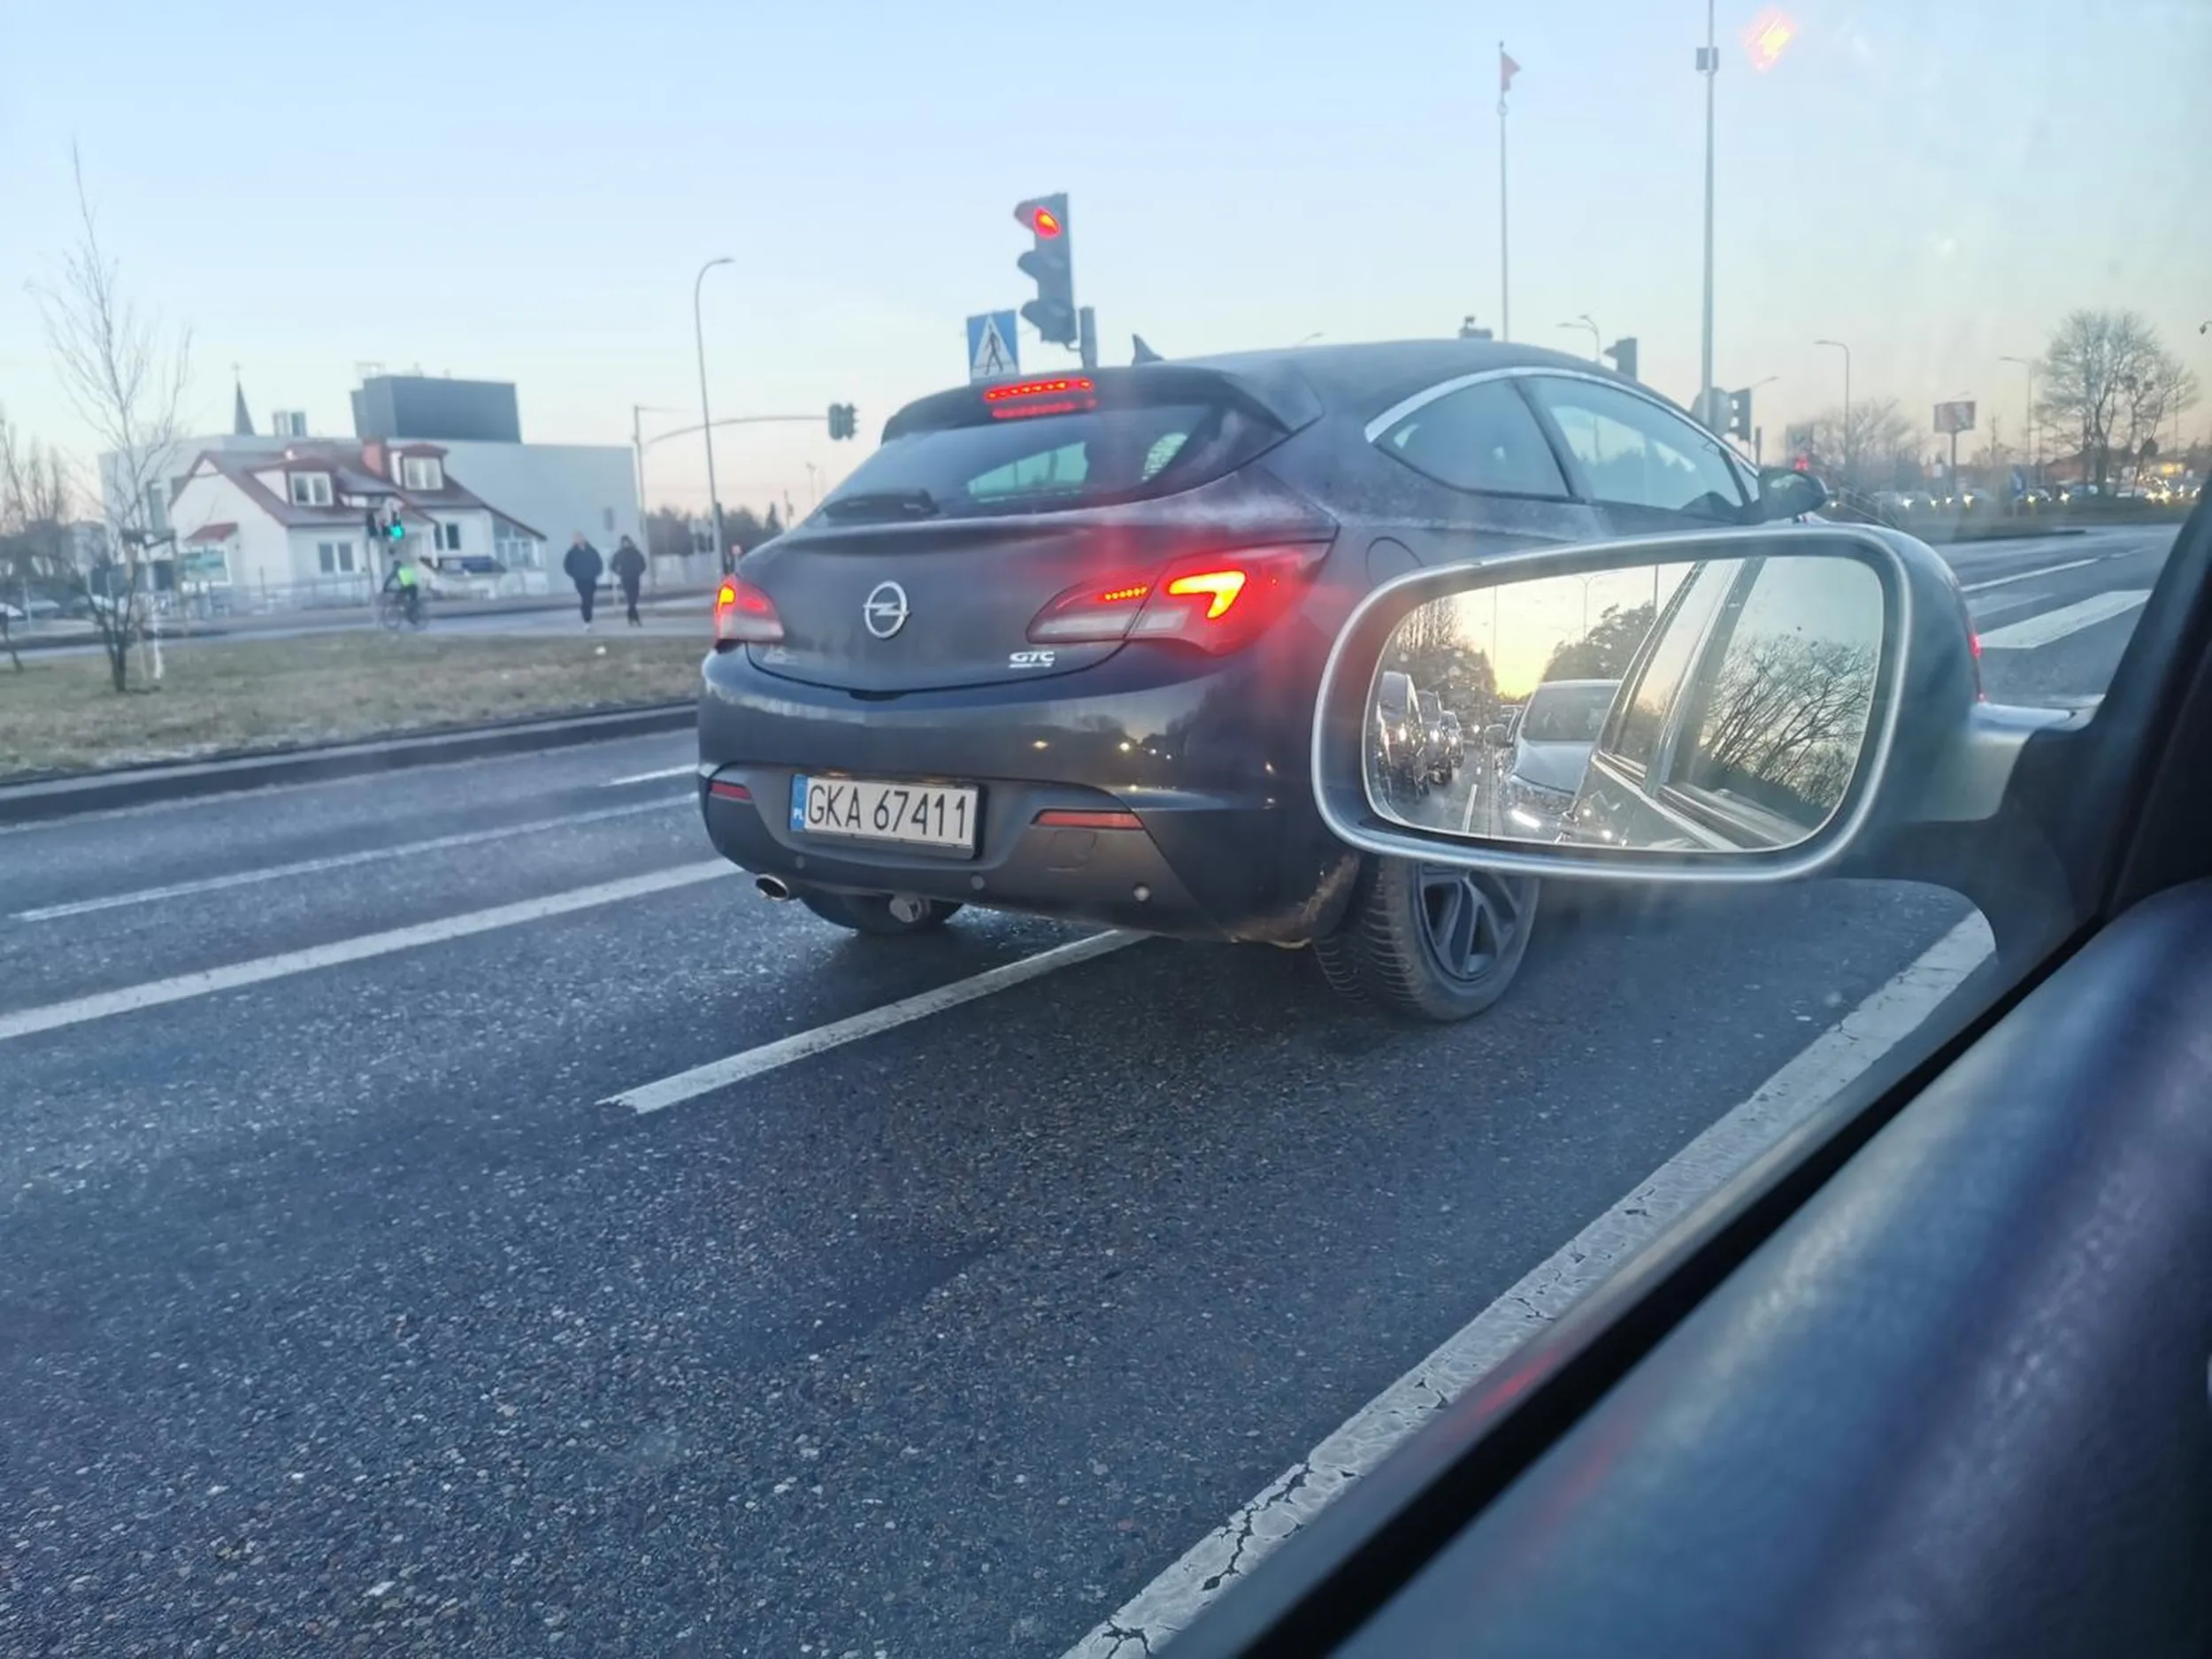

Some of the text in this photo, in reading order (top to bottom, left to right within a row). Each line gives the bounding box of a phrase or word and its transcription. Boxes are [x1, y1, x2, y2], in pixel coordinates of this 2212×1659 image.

[1009, 650, 1056, 663] GTC
[808, 784, 966, 840] GKA 67411
